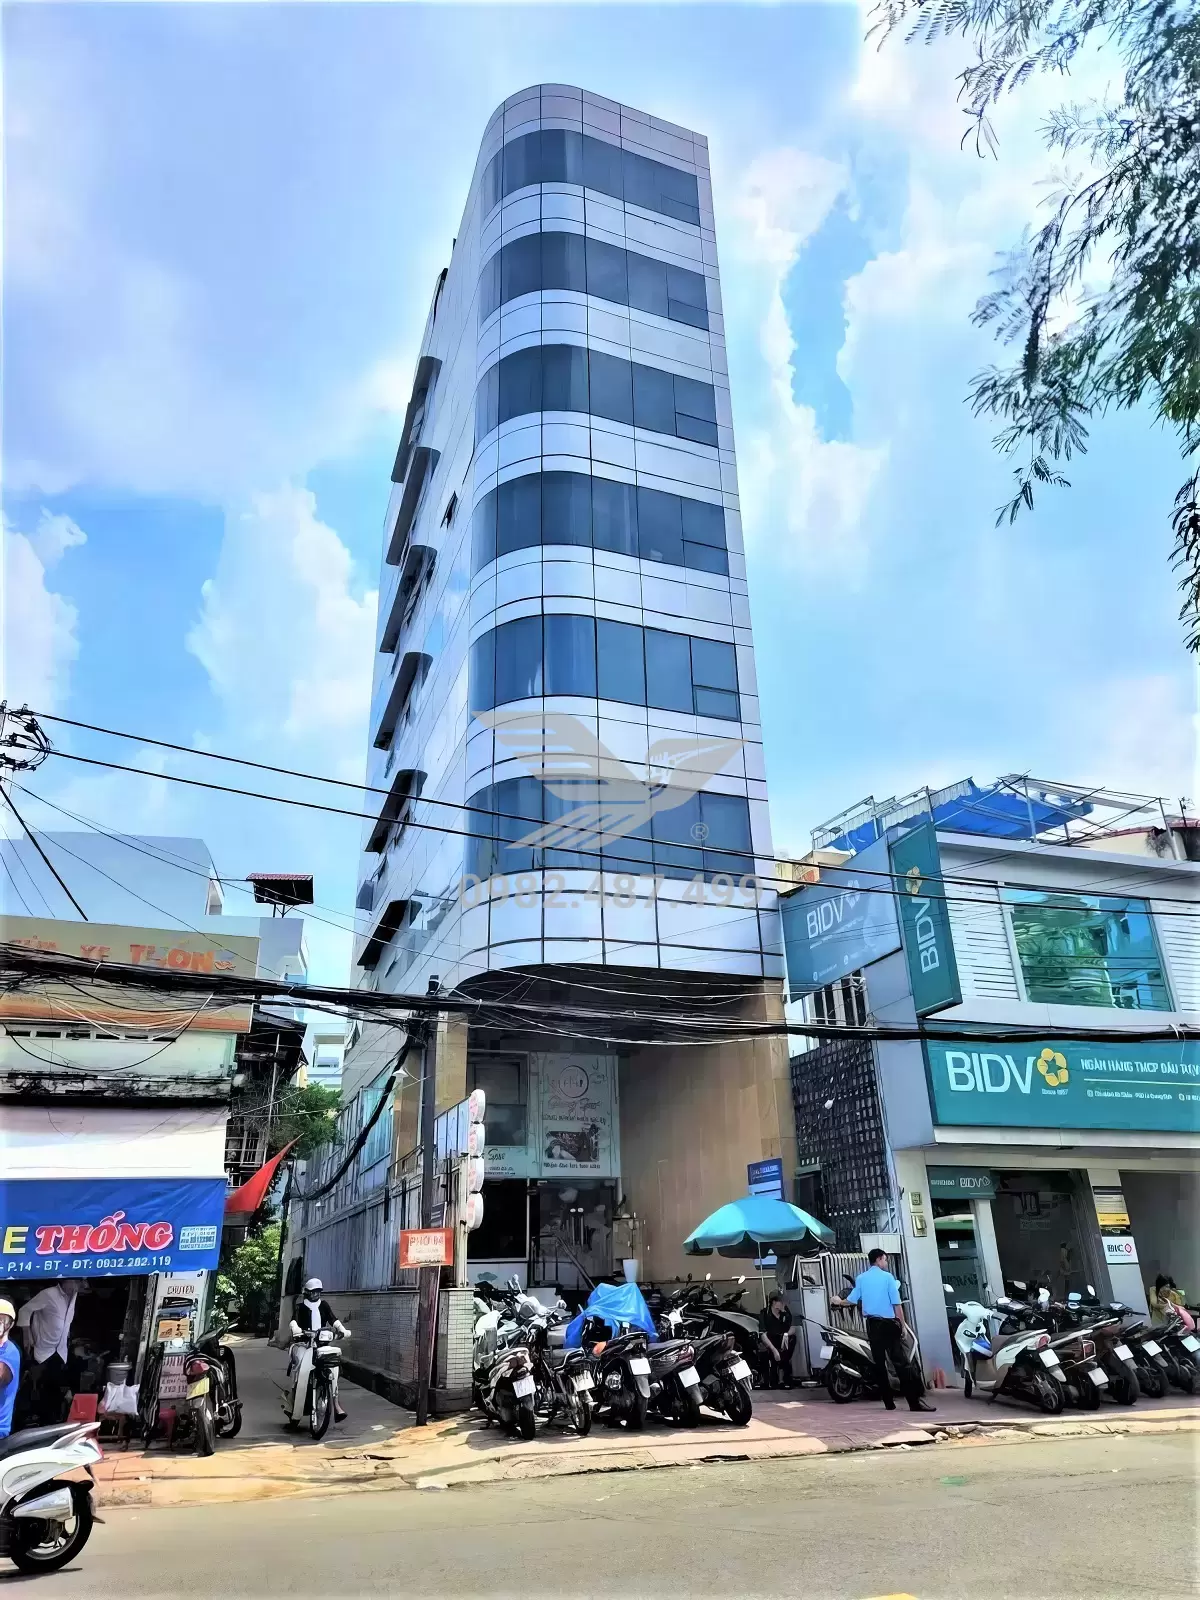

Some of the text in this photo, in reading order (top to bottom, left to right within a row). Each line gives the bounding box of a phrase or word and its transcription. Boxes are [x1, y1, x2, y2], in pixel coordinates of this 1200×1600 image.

[806, 895, 844, 939] BIDV
[911, 895, 940, 974] BIDV
[945, 1050, 1037, 1094] BIDV
[35, 1210, 174, 1255] THỐNG
